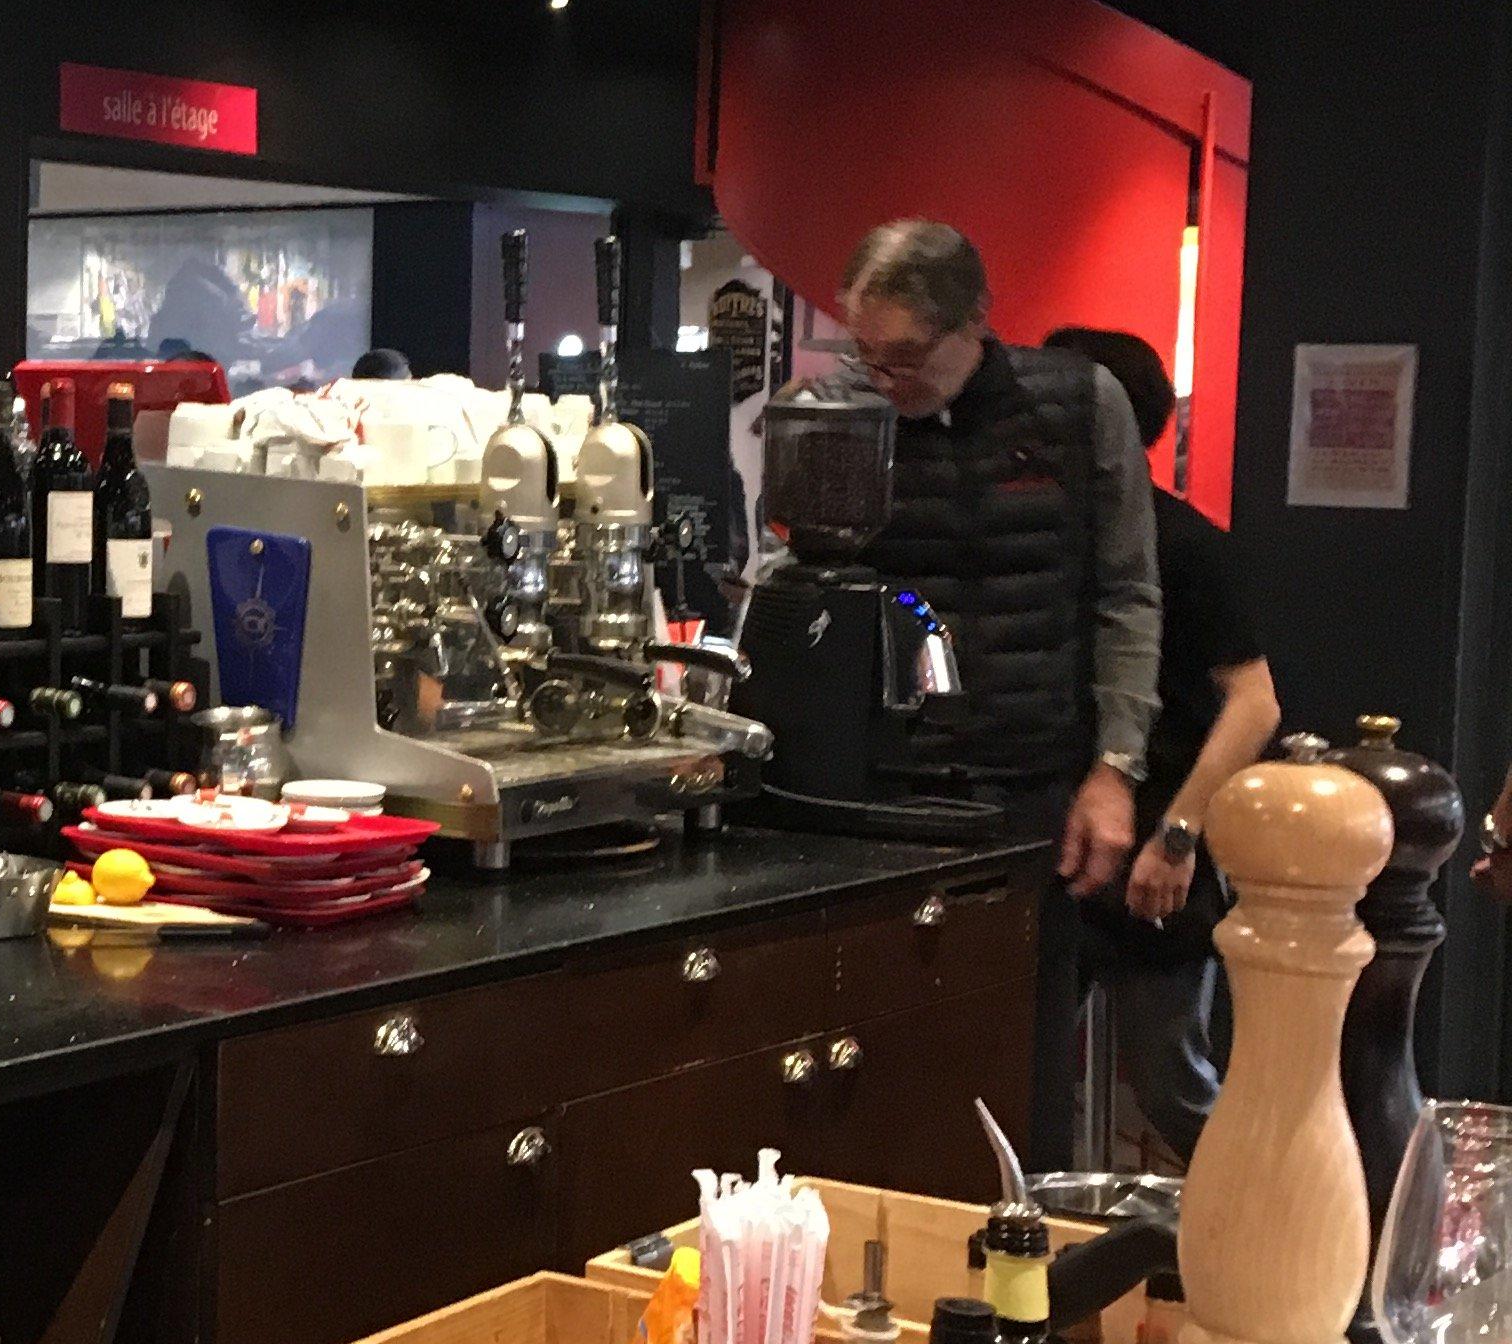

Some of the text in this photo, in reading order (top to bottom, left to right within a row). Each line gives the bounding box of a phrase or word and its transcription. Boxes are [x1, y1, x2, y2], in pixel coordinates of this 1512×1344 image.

[102, 89, 219, 141] salle à l'étage
